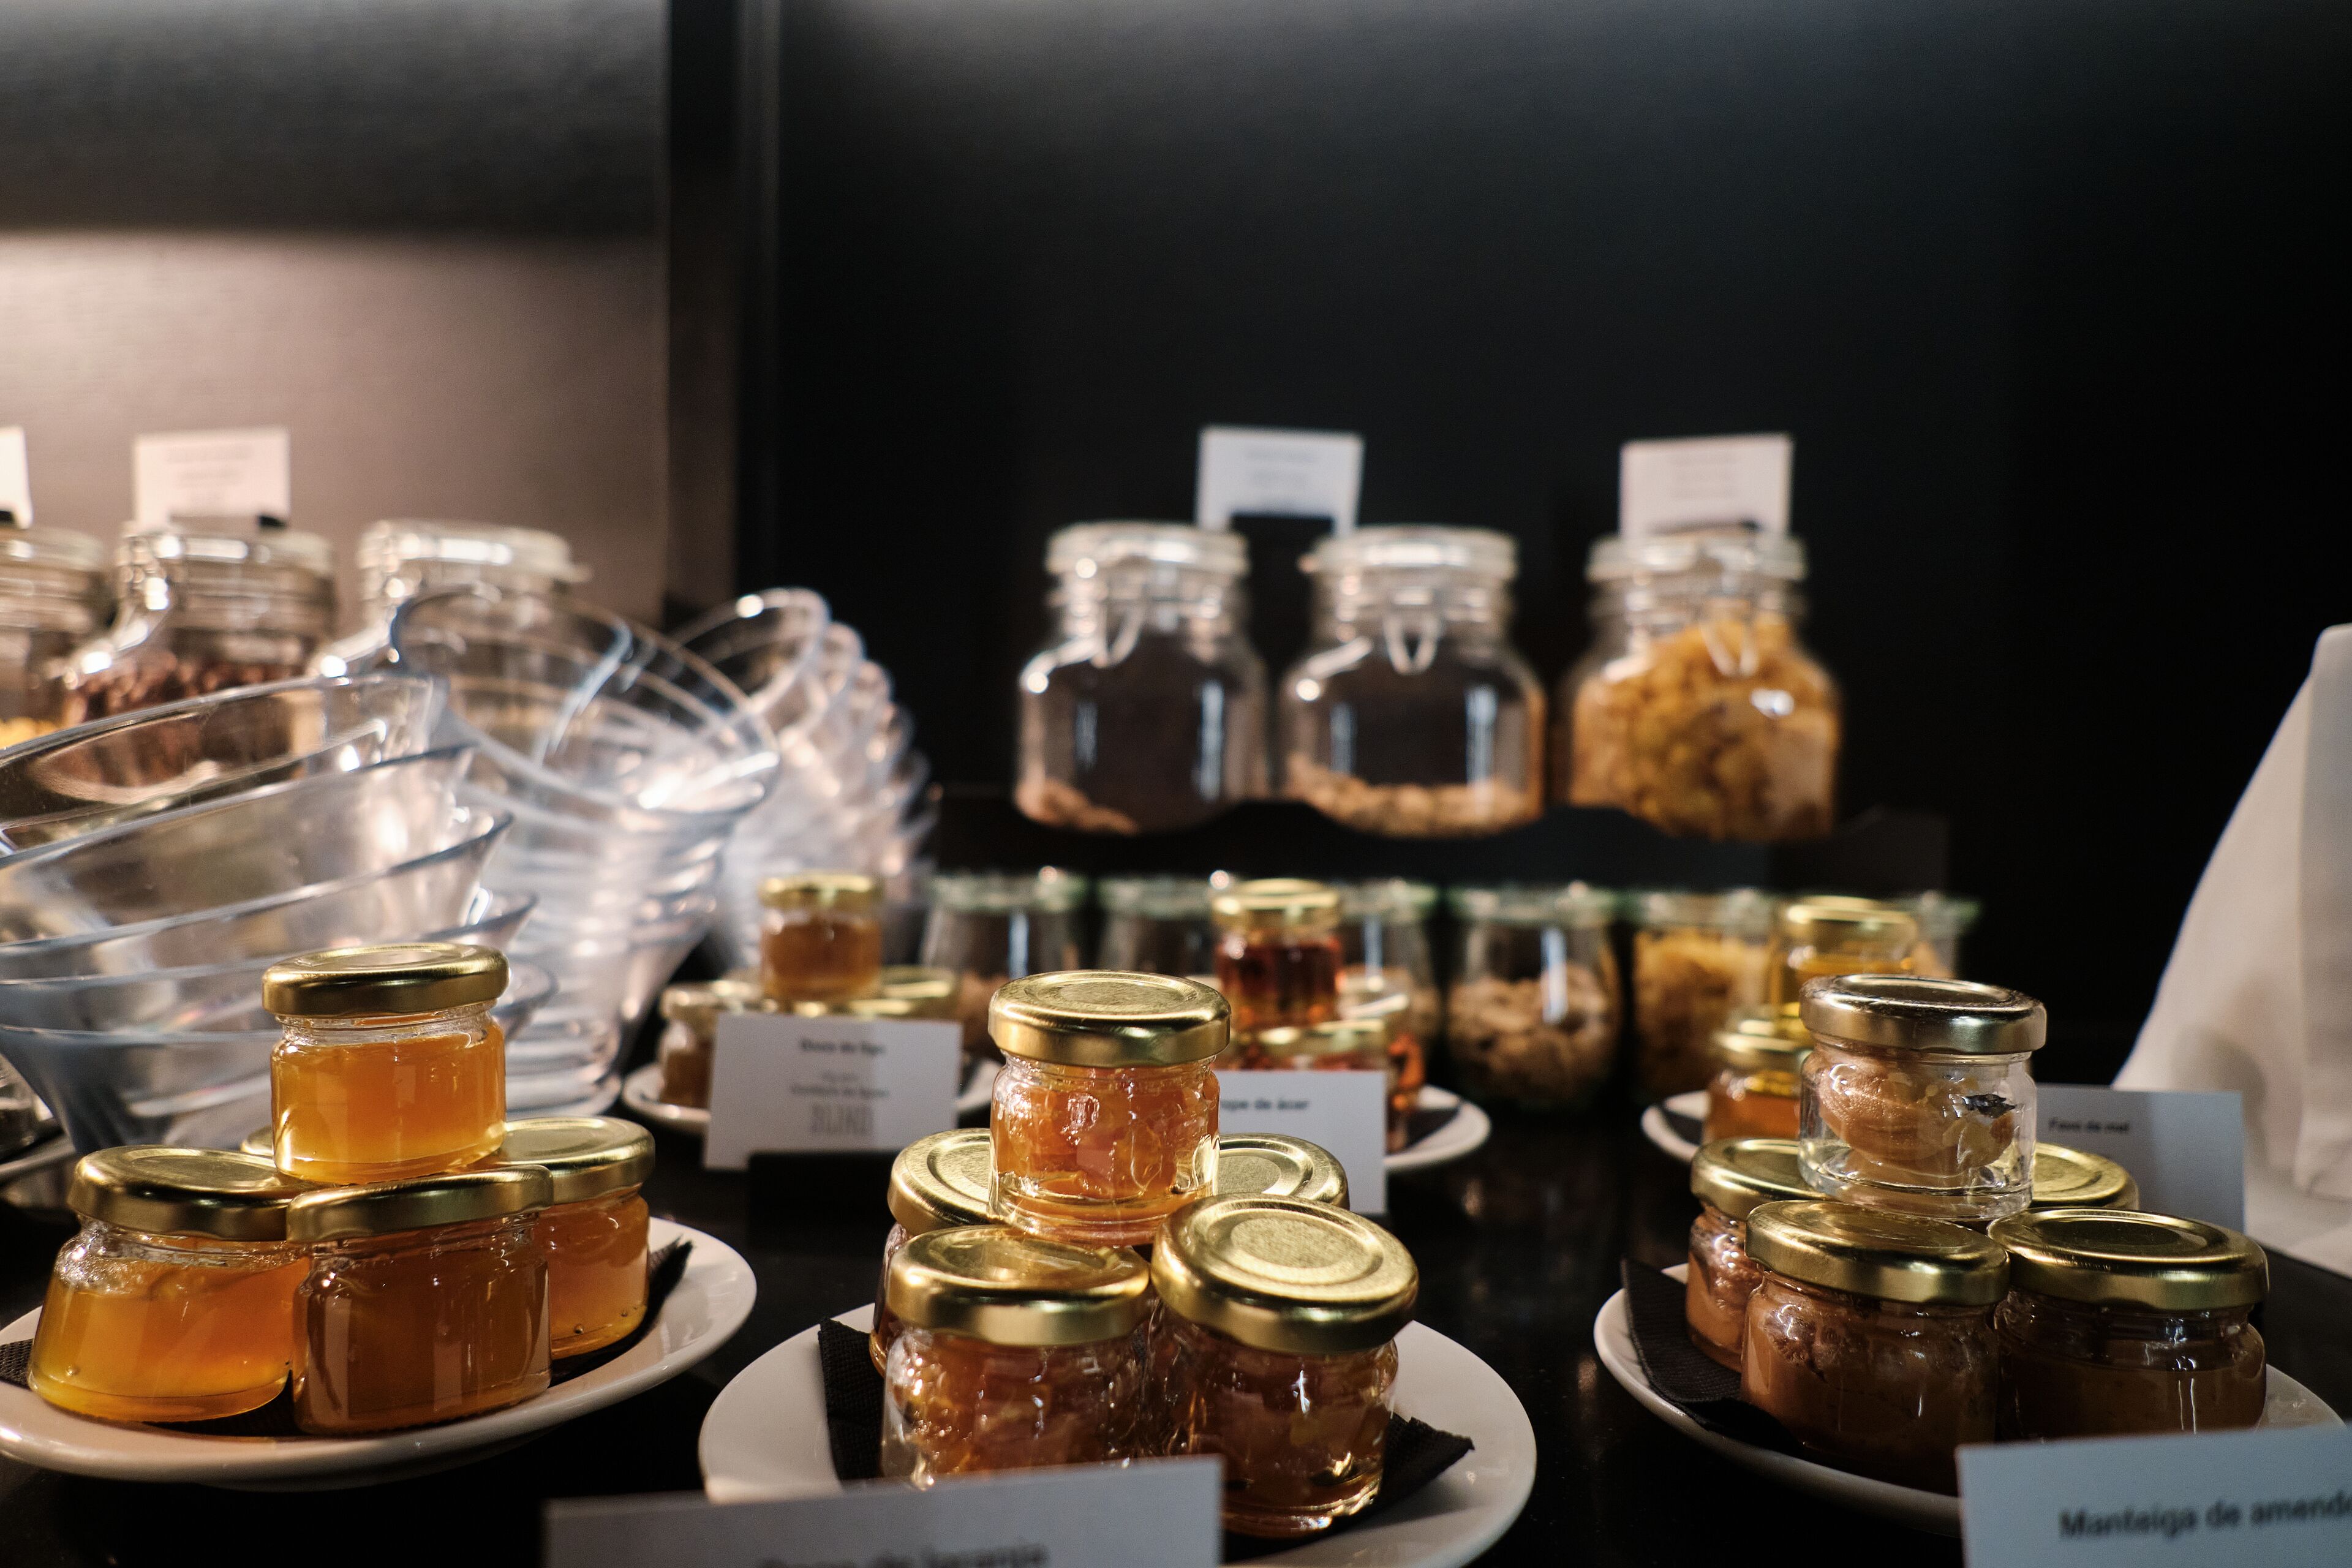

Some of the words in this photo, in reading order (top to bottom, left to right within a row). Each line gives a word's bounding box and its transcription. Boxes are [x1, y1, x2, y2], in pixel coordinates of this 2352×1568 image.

[1254, 1098, 1272, 1110] de
[2059, 1505, 2197, 1541] Manteiga
[2205, 1498, 2242, 1529] de
